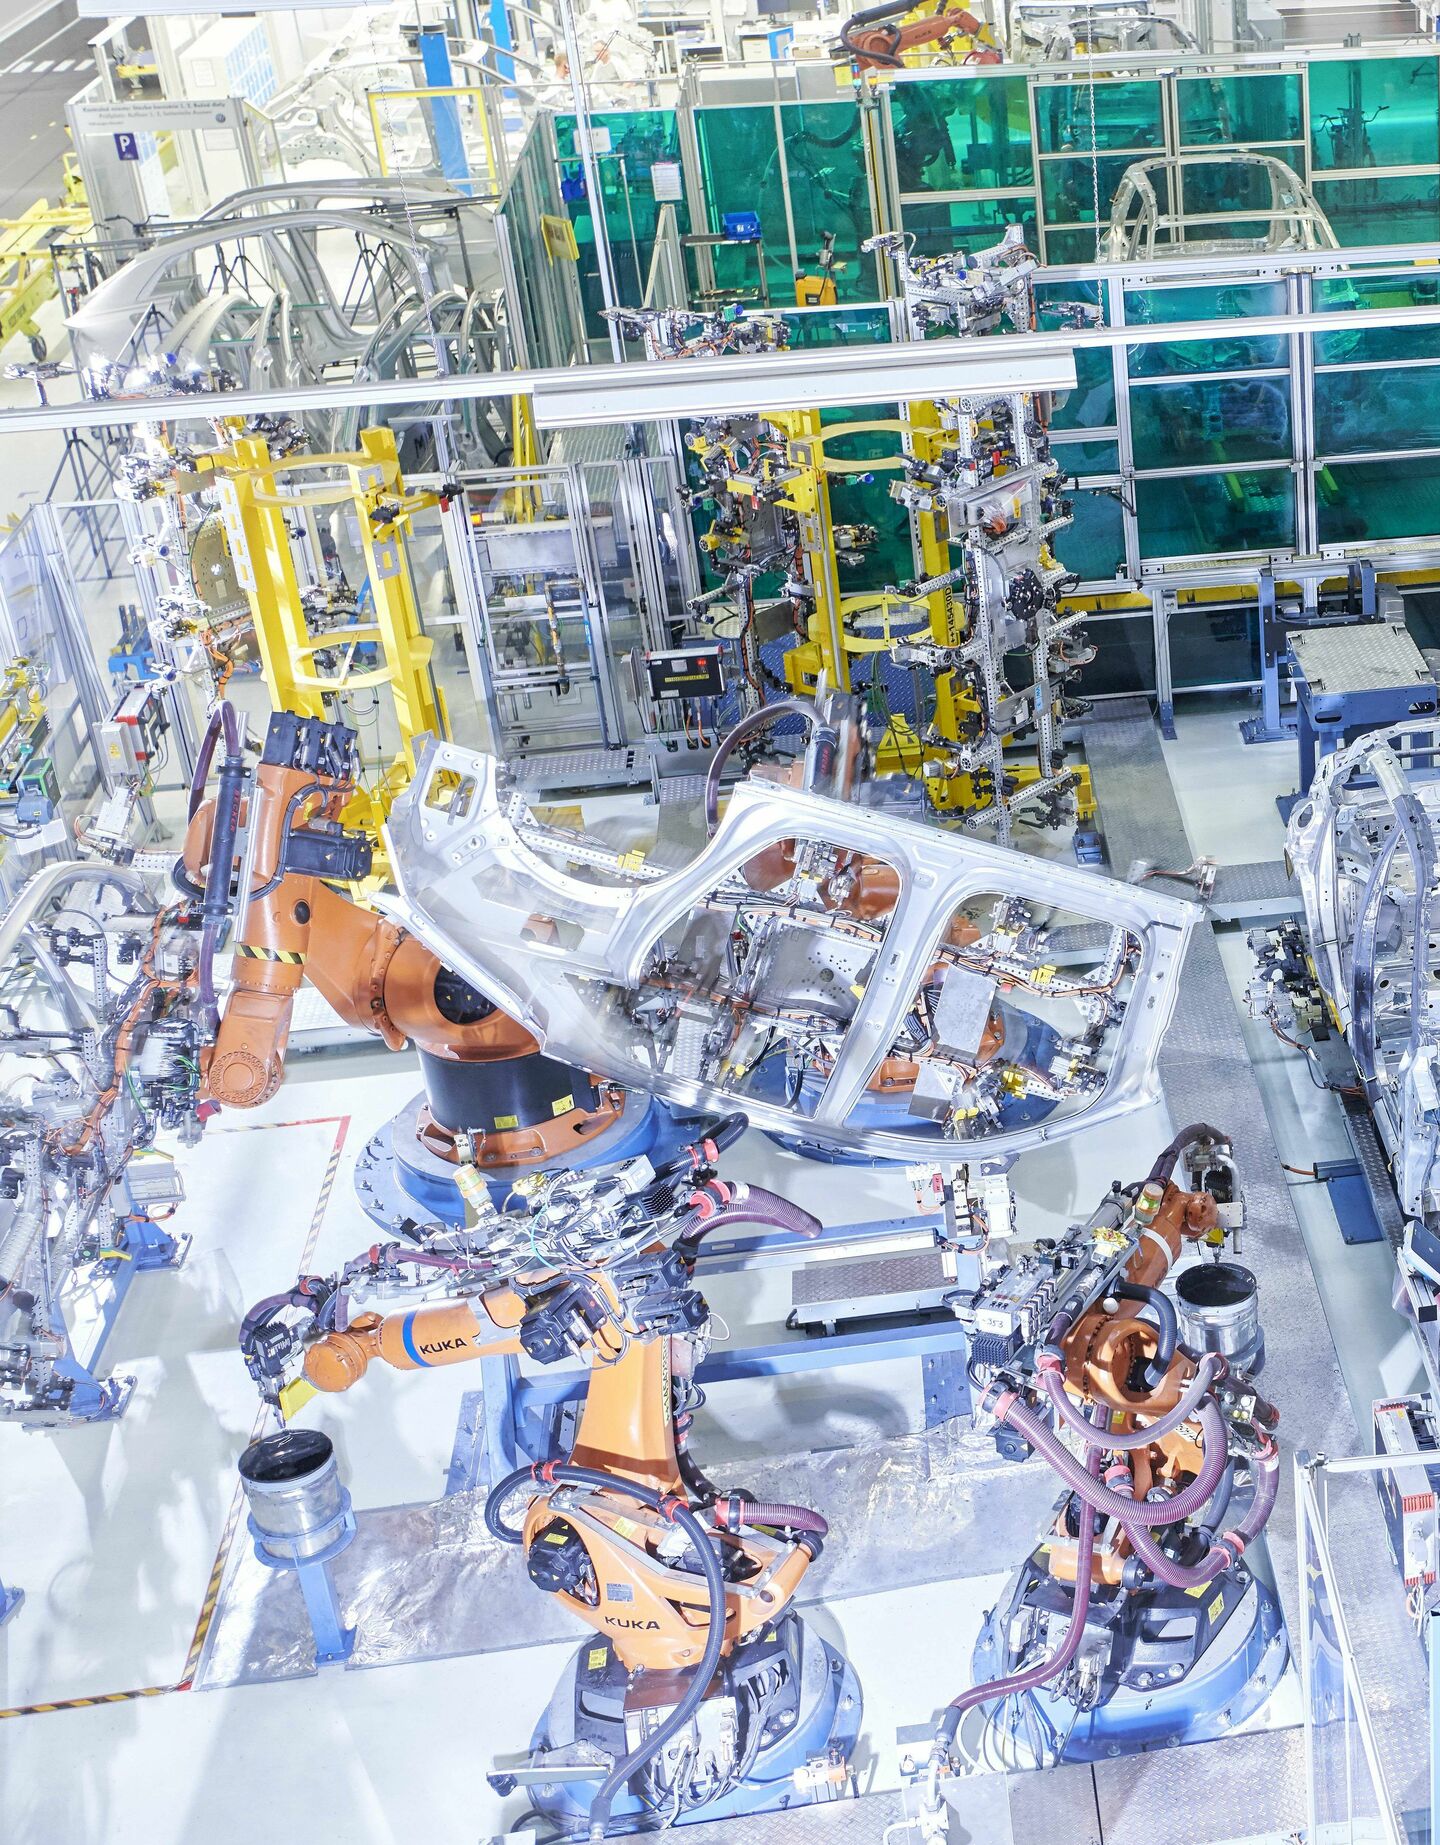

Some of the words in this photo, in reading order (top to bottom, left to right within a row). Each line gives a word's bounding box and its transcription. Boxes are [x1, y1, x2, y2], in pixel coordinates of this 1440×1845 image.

[119, 135, 130, 153] P
[420, 1338, 468, 1355] KUKA
[604, 1616, 660, 1630] KUKA
